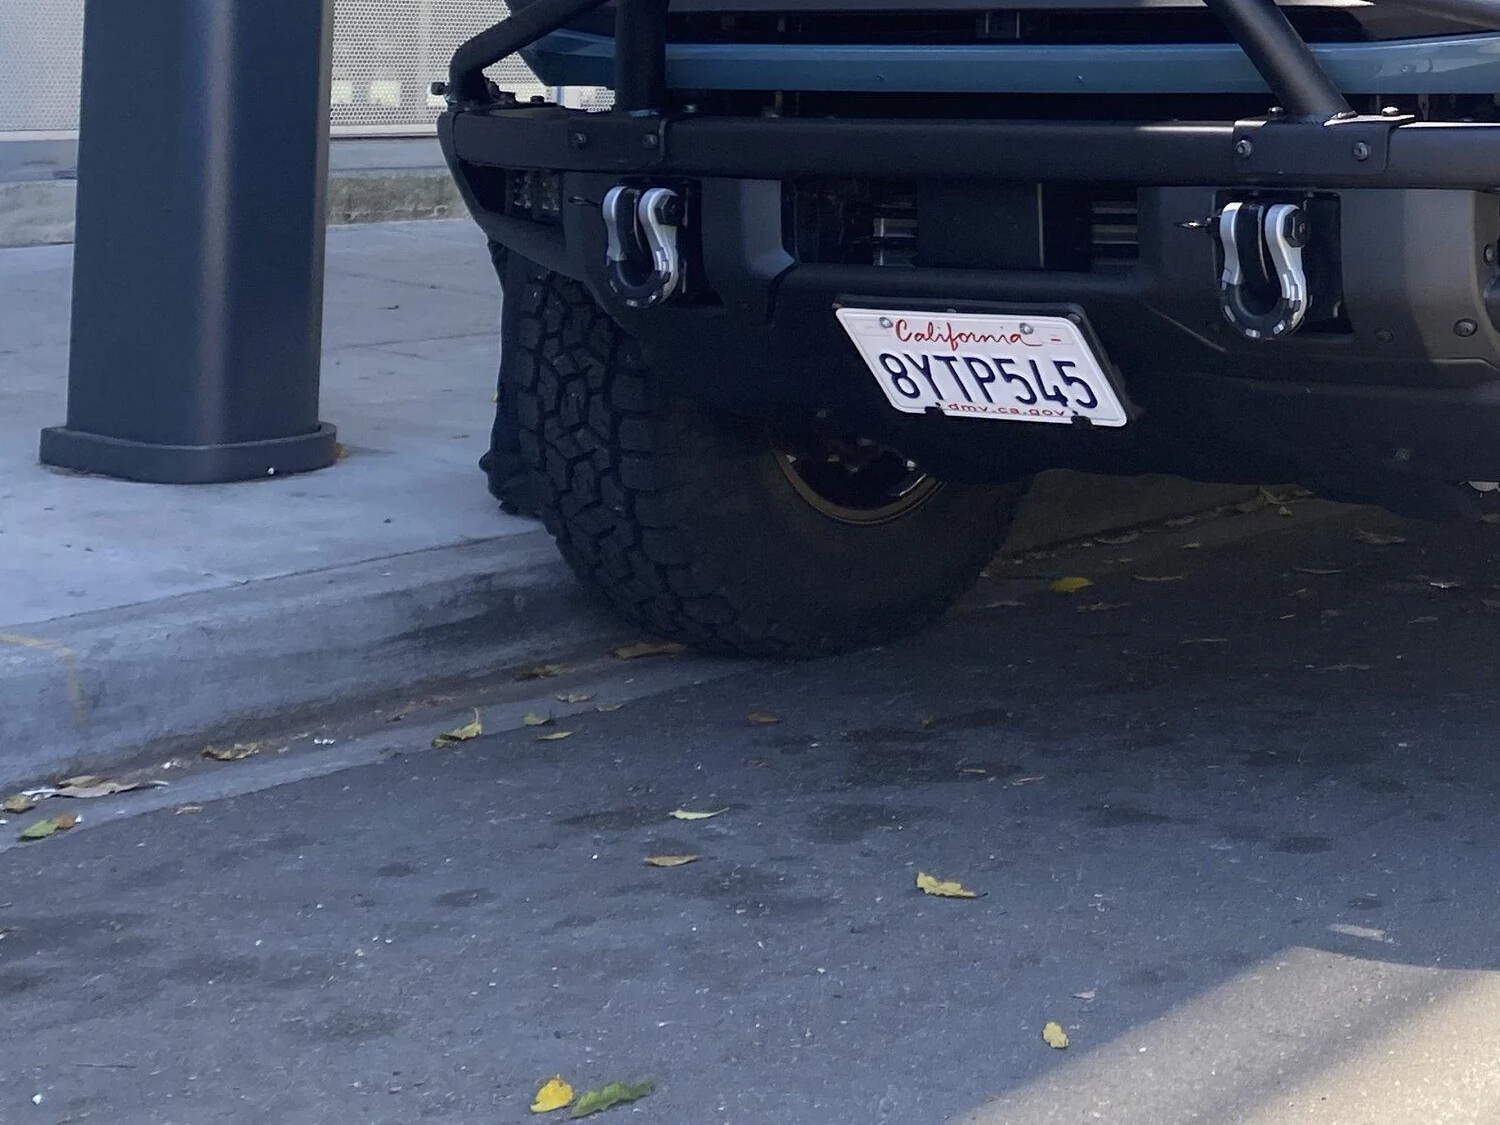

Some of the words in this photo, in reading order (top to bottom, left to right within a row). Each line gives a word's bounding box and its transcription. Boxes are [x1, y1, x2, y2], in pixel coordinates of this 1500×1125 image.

[894, 318, 1043, 351] California
[878, 352, 1099, 409] 8YTP545
[948, 402, 1066, 417] dmv.ca.gov
